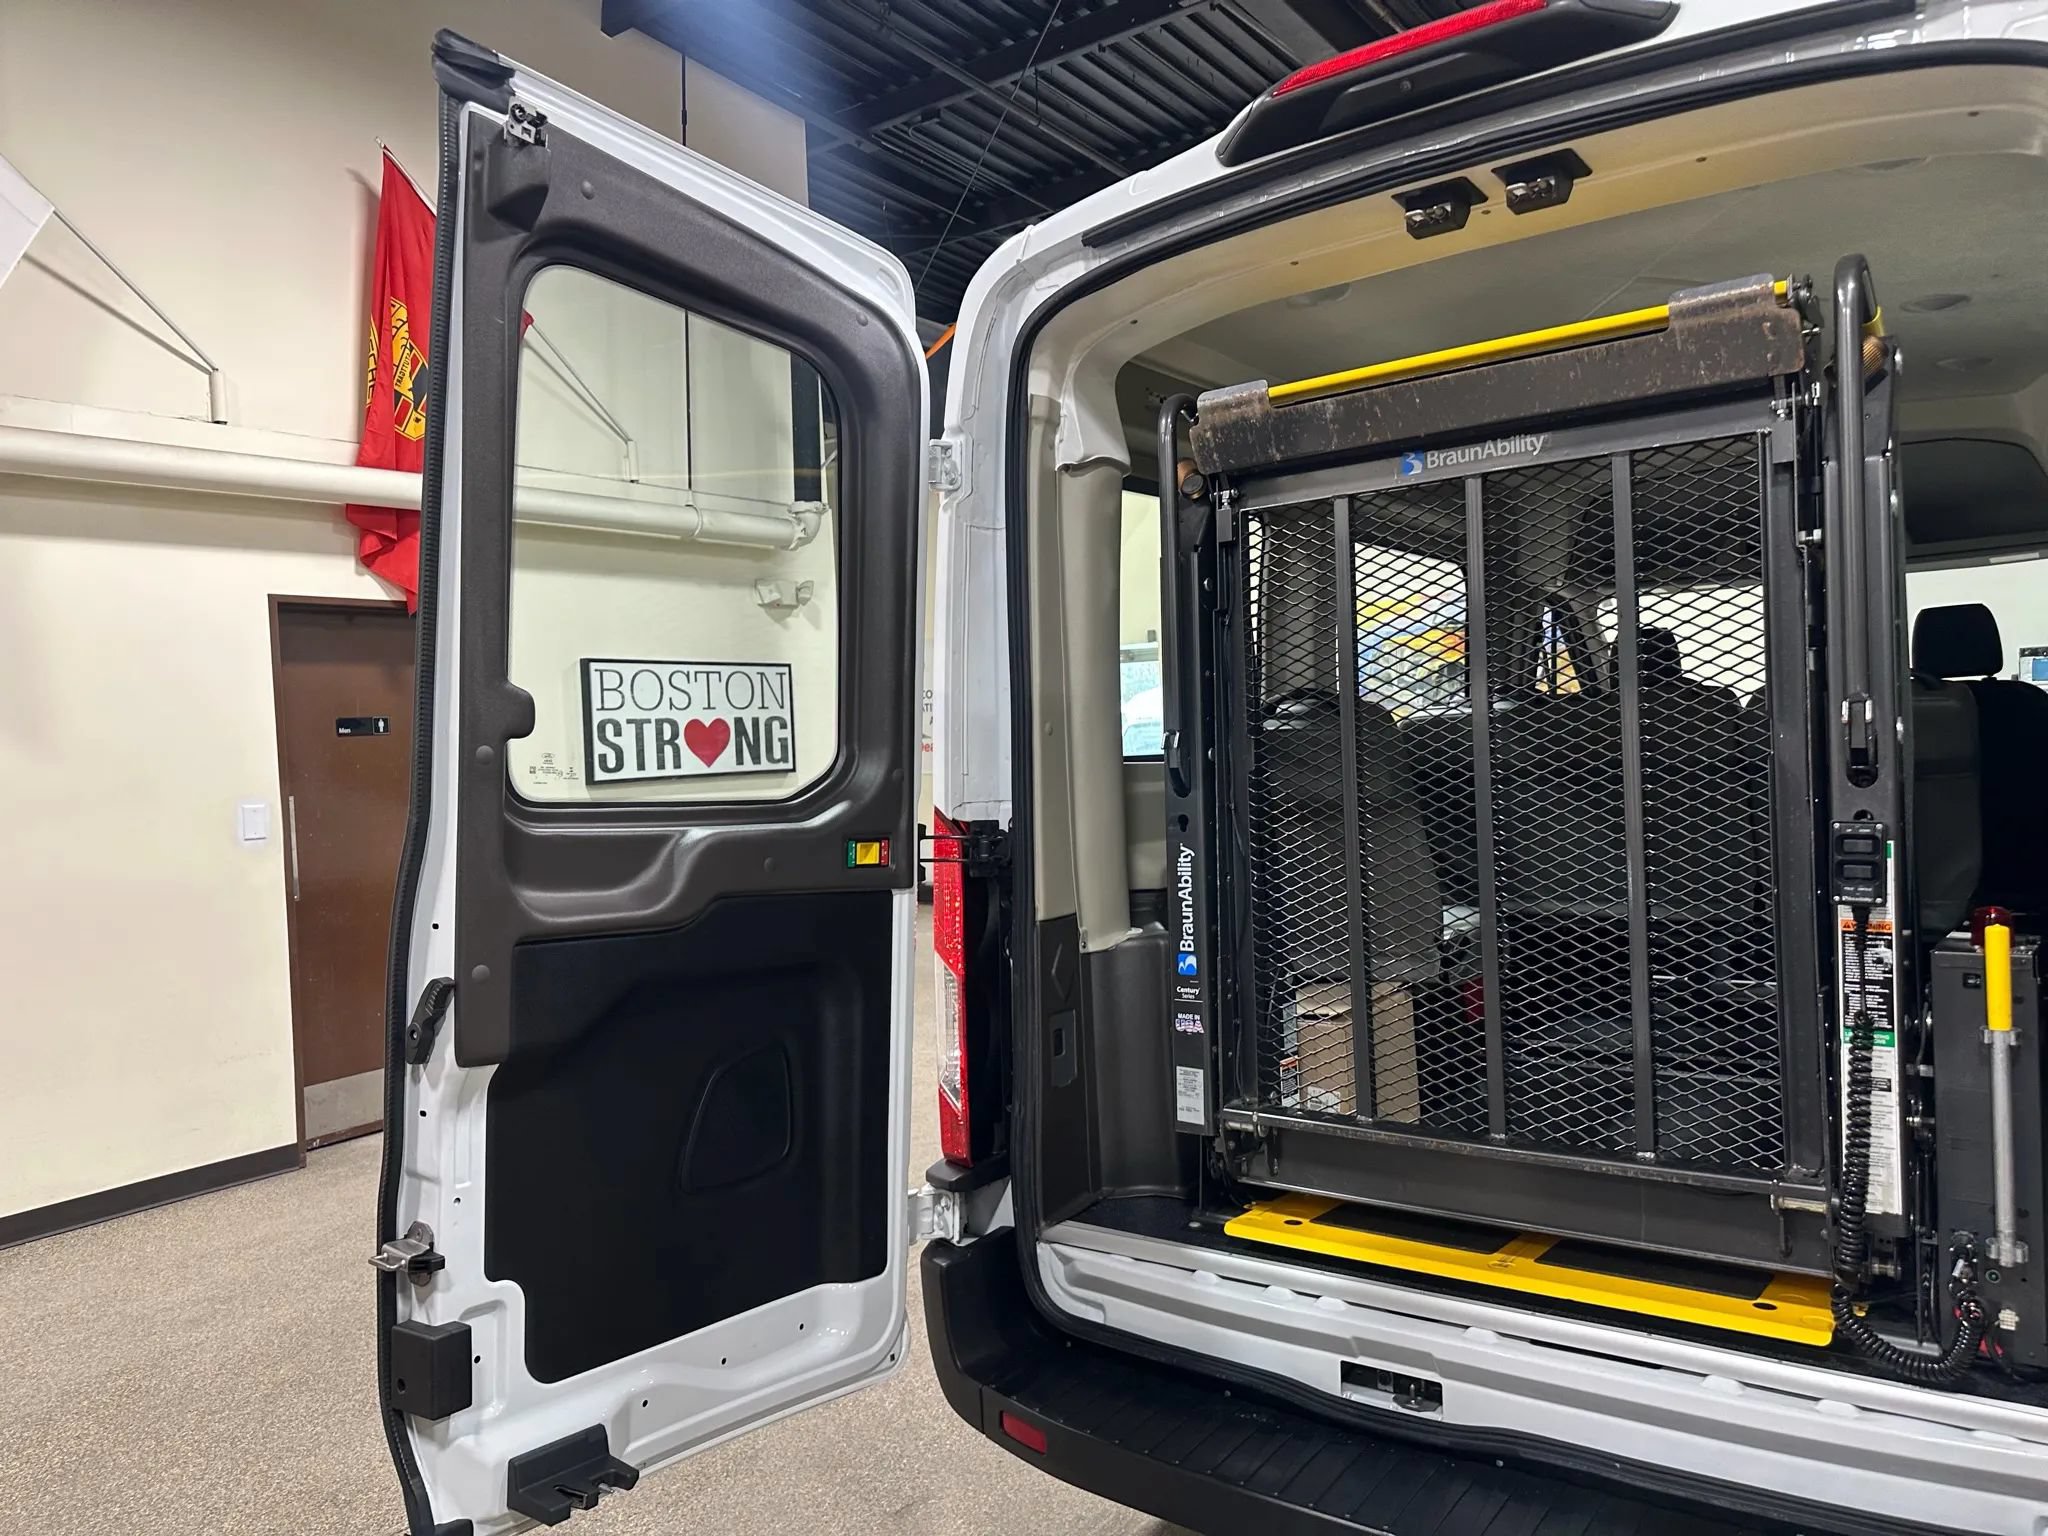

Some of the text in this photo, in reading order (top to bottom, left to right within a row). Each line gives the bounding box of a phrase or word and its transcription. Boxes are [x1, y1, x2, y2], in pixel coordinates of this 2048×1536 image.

[1426, 434, 1546, 469] BraunAbility
[594, 668, 787, 711] BOSTON
[596, 716, 790, 774] STRNG
[1177, 845, 1196, 952] BraunAbility
[1850, 921, 1892, 931] WNING
[1176, 986, 1201, 996] Century
[1175, 1019, 1205, 1034] USA
